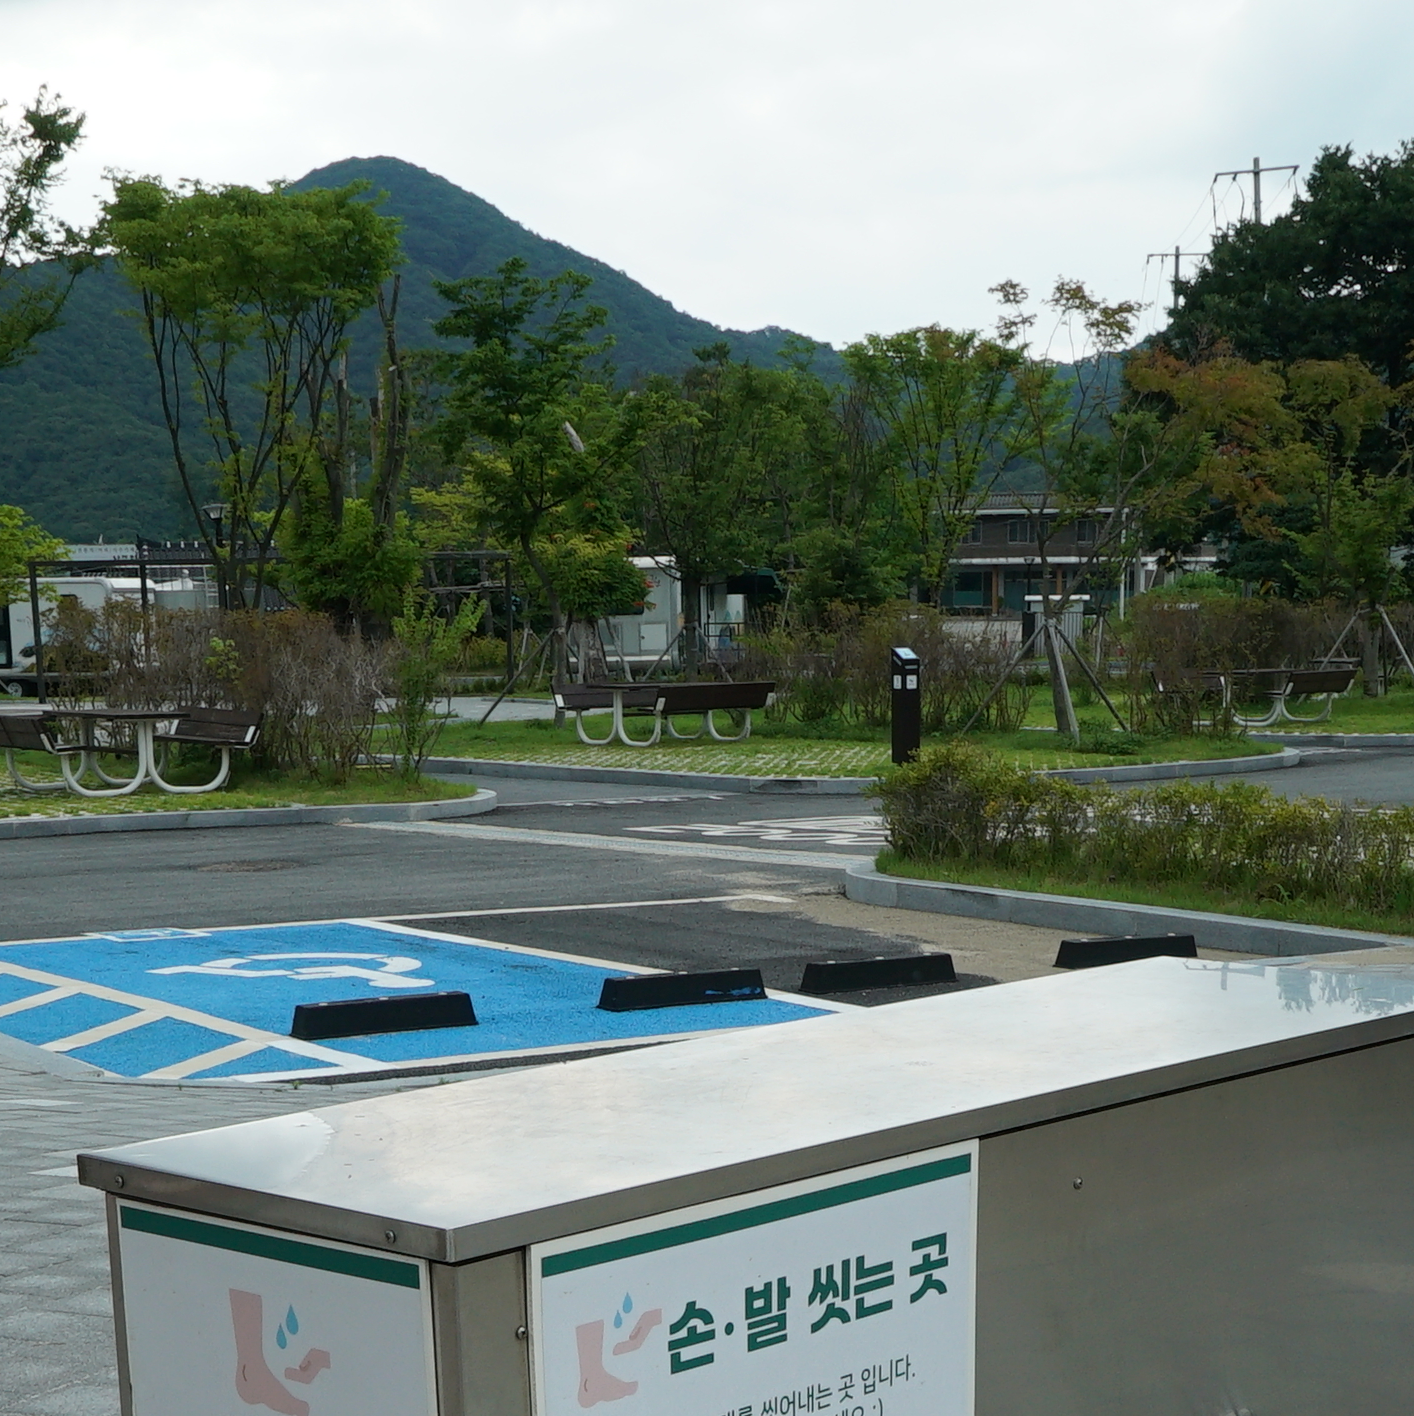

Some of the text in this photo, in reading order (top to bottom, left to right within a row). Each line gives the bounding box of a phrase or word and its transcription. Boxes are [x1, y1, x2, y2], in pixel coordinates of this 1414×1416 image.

[667, 1232, 949, 1375] 손·발 씻는 곳
[838, 1373, 856, 1402] 곳
[860, 1354, 916, 1394] 입니다.
